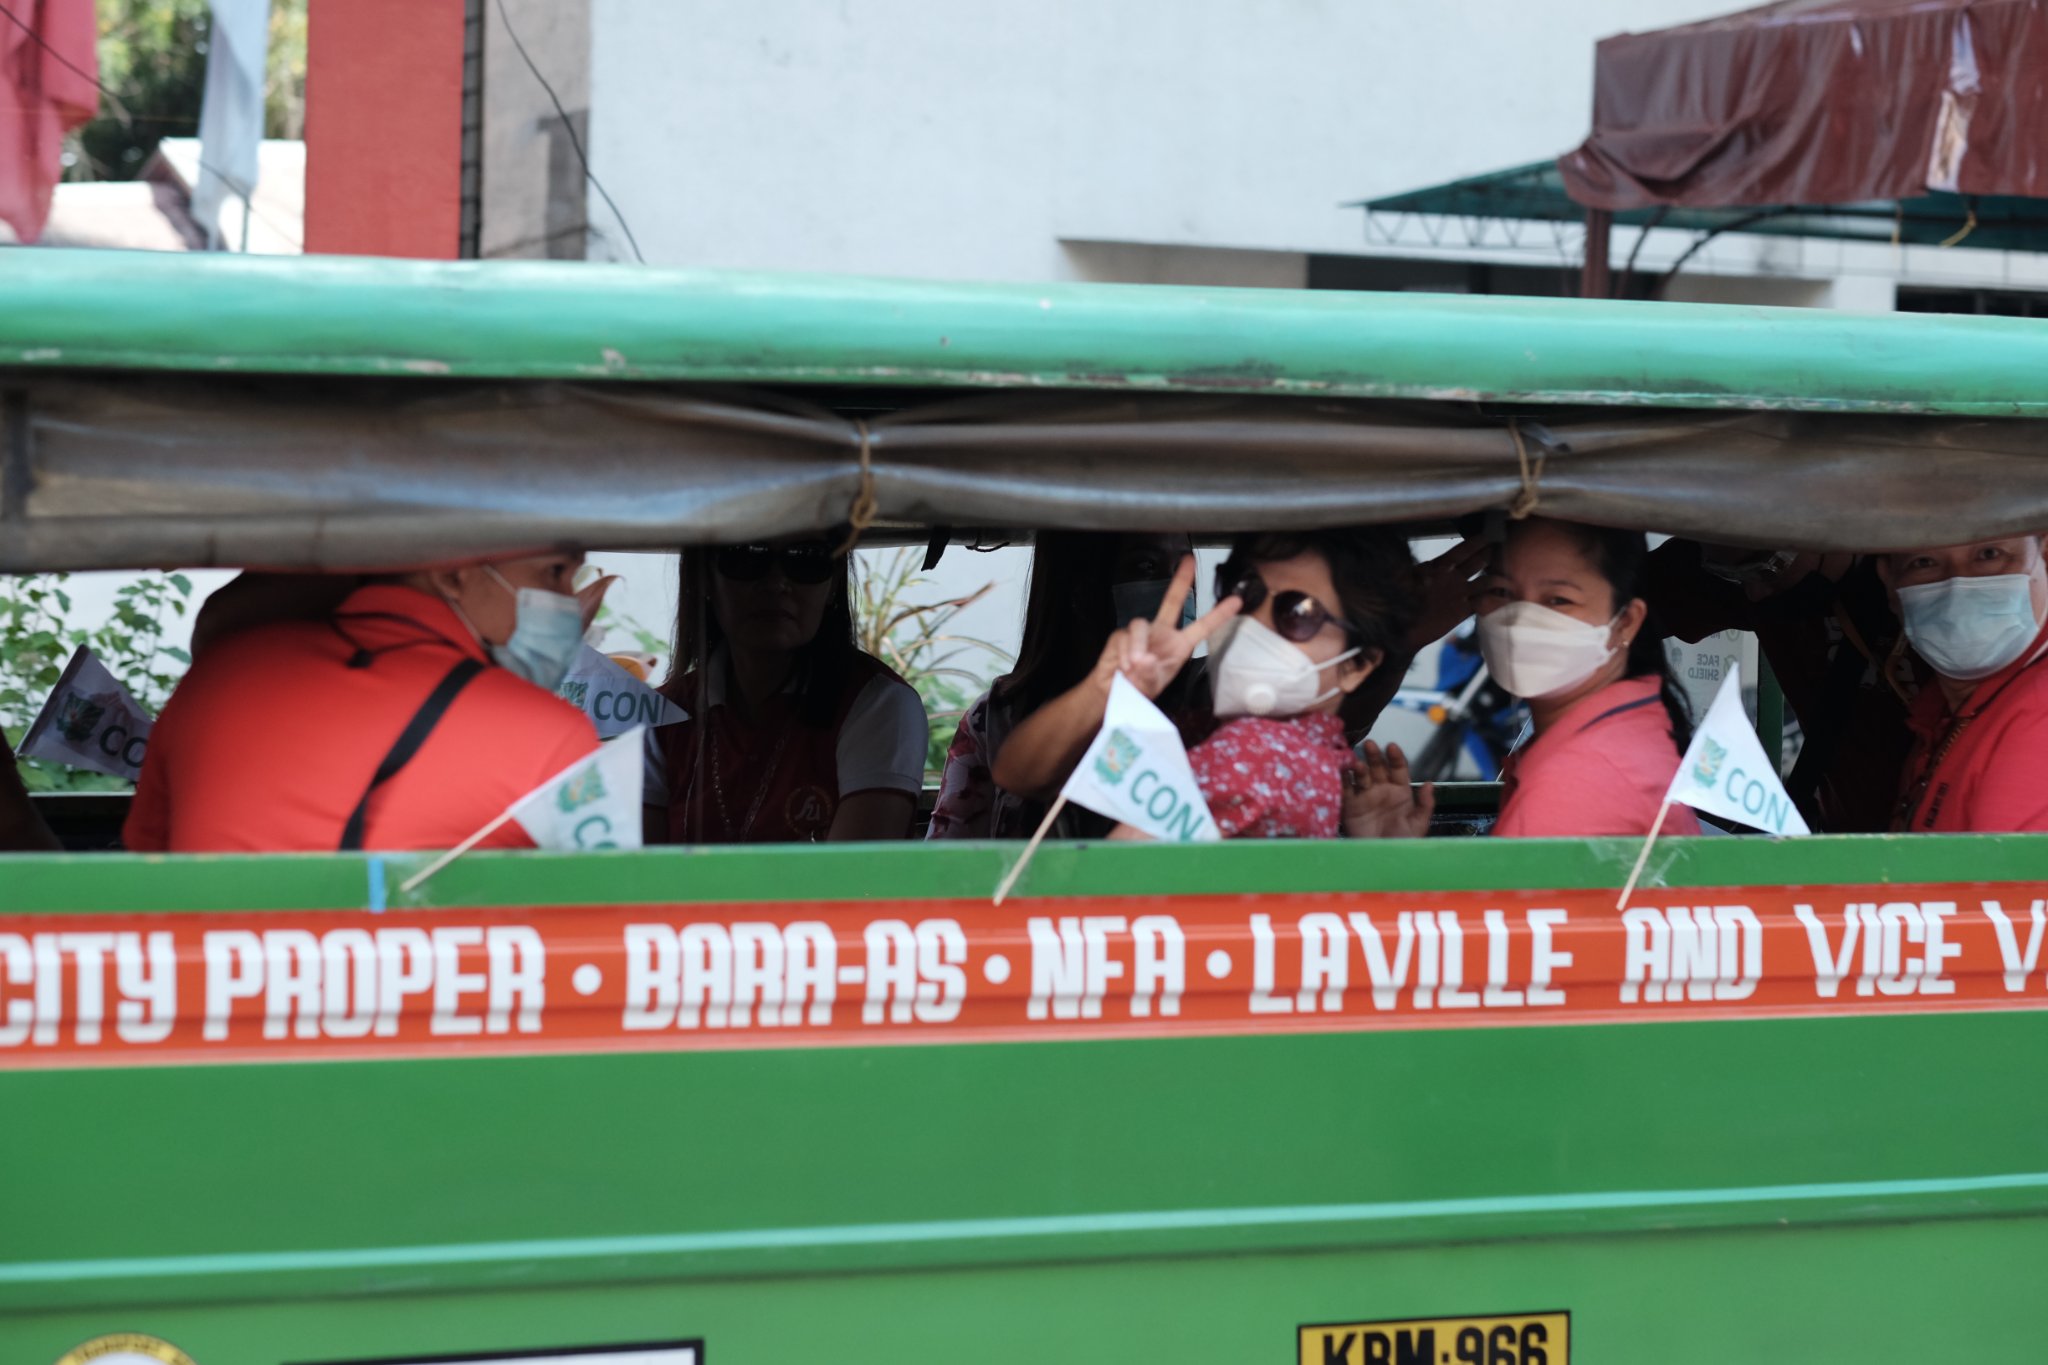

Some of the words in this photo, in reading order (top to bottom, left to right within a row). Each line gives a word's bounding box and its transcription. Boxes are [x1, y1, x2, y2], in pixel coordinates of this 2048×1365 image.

[593, 690, 661, 724] CON
[573, 815, 618, 848] C
[1130, 769, 1205, 841] CON
[1726, 767, 1790, 832] CON
[0, 932, 177, 1047] CITY
[203, 926, 546, 1041] PROPER
[1027, 916, 1186, 1019] NFA
[1620, 906, 1764, 1003] AND
[1793, 902, 1962, 998] VICE
